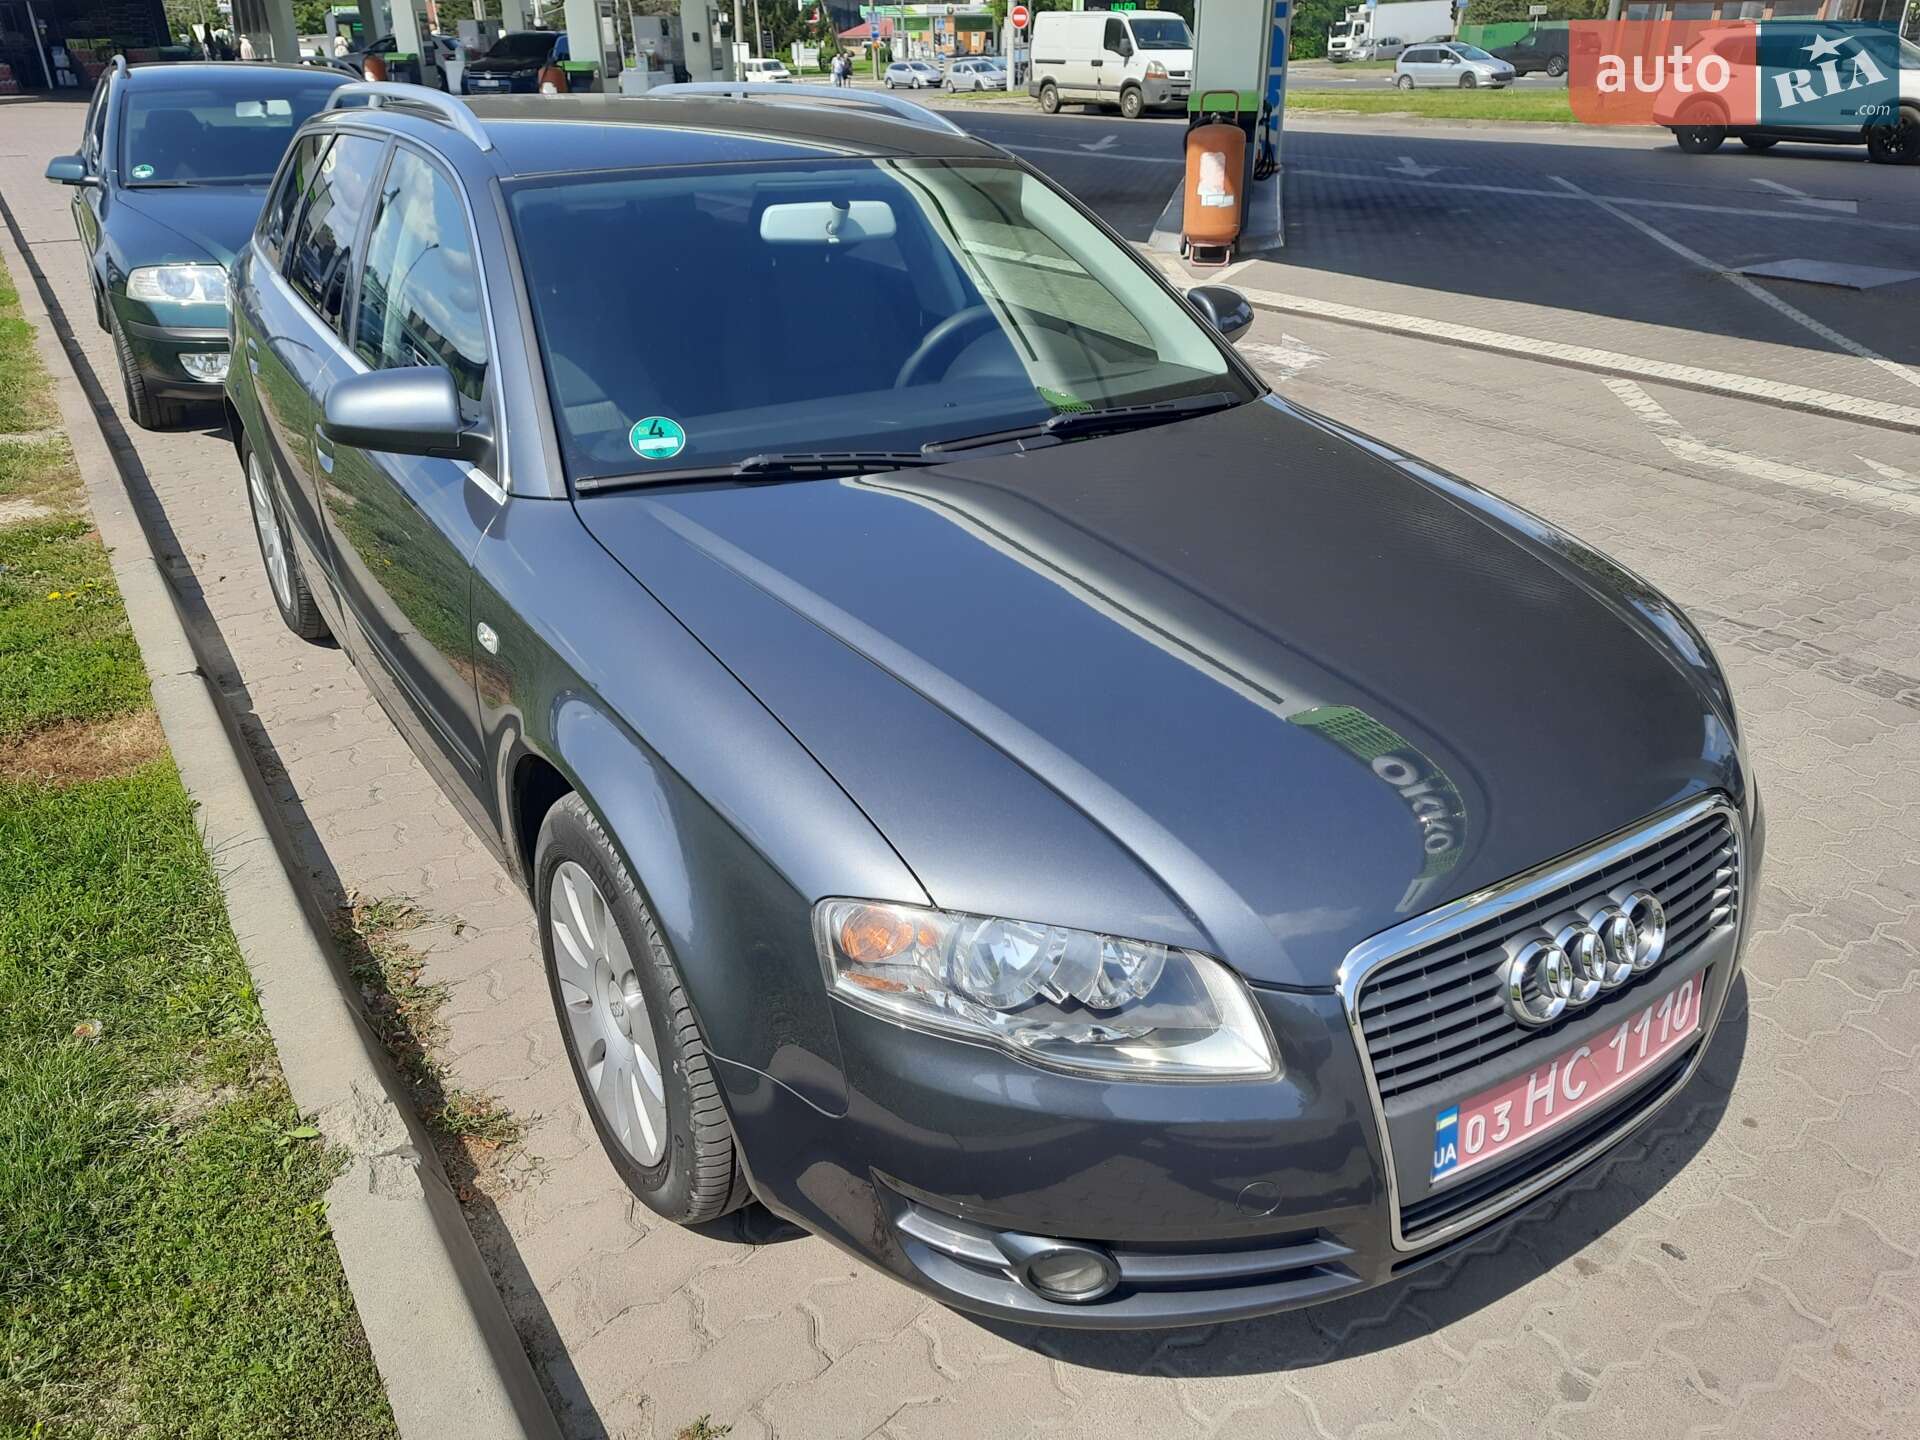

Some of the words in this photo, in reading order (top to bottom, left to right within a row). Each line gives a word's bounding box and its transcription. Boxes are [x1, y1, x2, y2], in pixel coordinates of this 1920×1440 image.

[650, 419, 664, 437] 4
[1464, 1100, 1512, 1155] 03
[1523, 1046, 1591, 1126] HC
[1609, 979, 1694, 1073] 1110
[1434, 1143, 1457, 1168] UA
